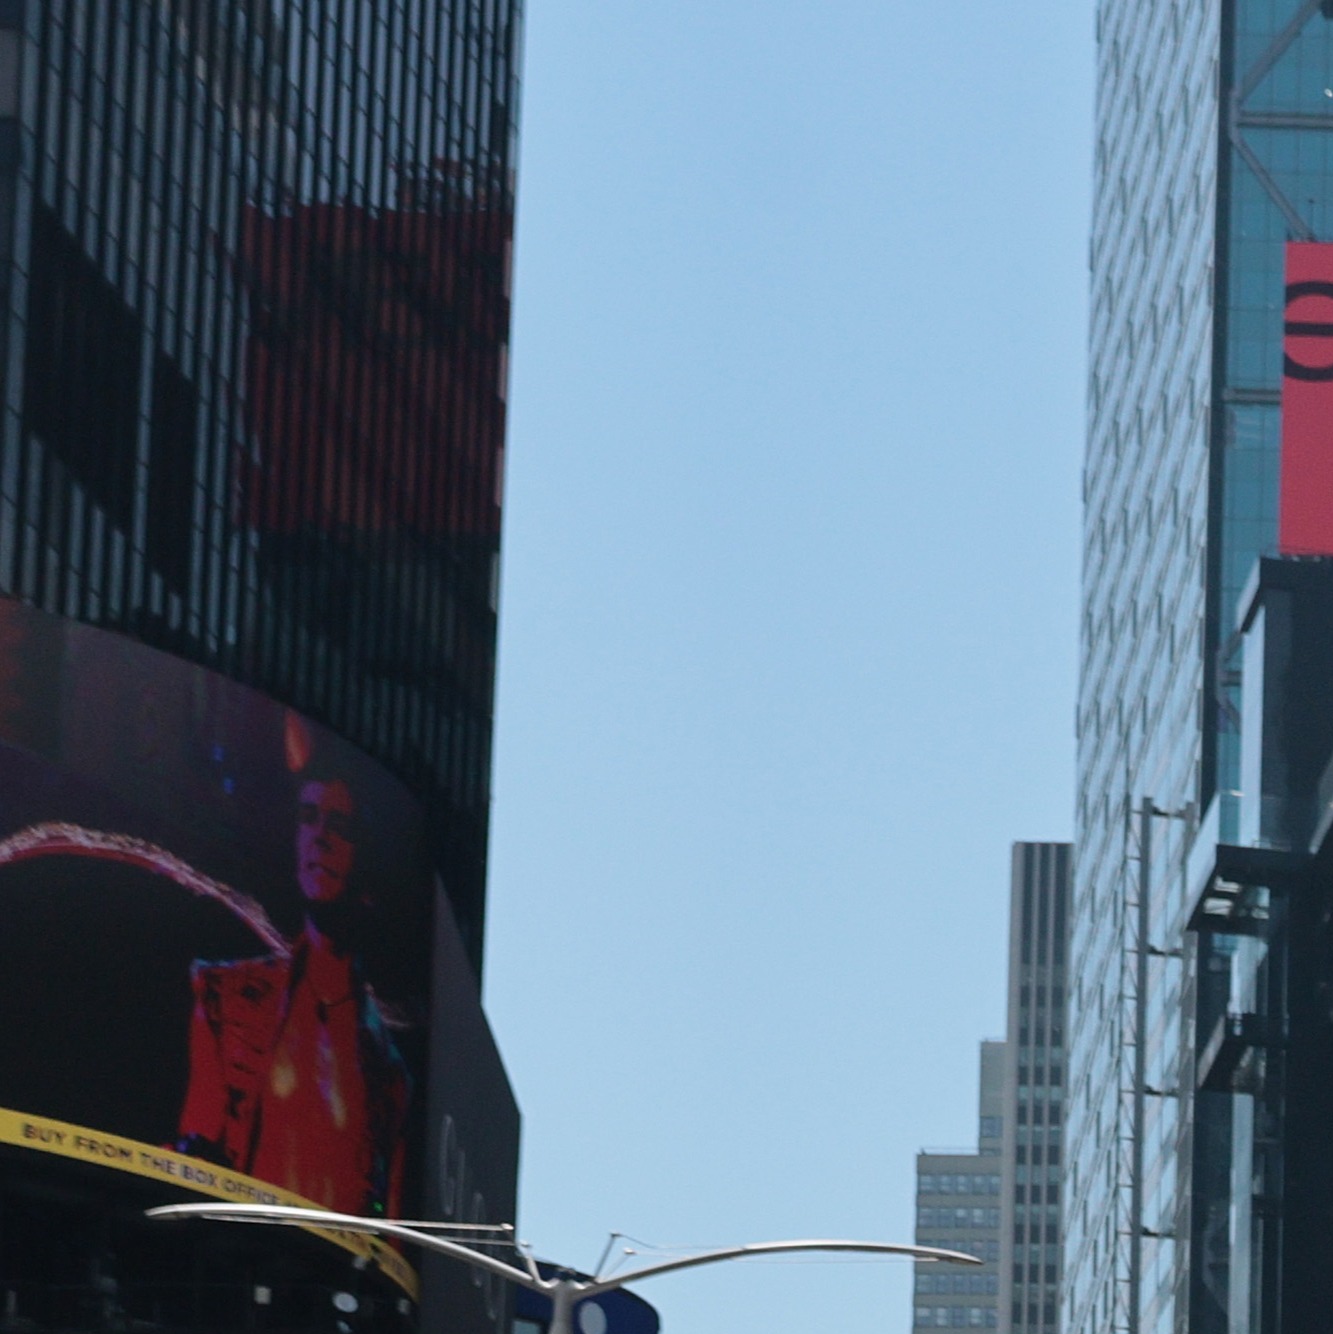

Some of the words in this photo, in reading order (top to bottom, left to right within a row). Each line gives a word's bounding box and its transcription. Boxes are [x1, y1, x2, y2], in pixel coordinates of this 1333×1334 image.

[22, 1123, 65, 1147] BUY
[74, 1135, 134, 1164] FROM
[140, 1152, 177, 1176] THE
[180, 1163, 218, 1188] BOX
[222, 1176, 280, 1206] OFFICE
